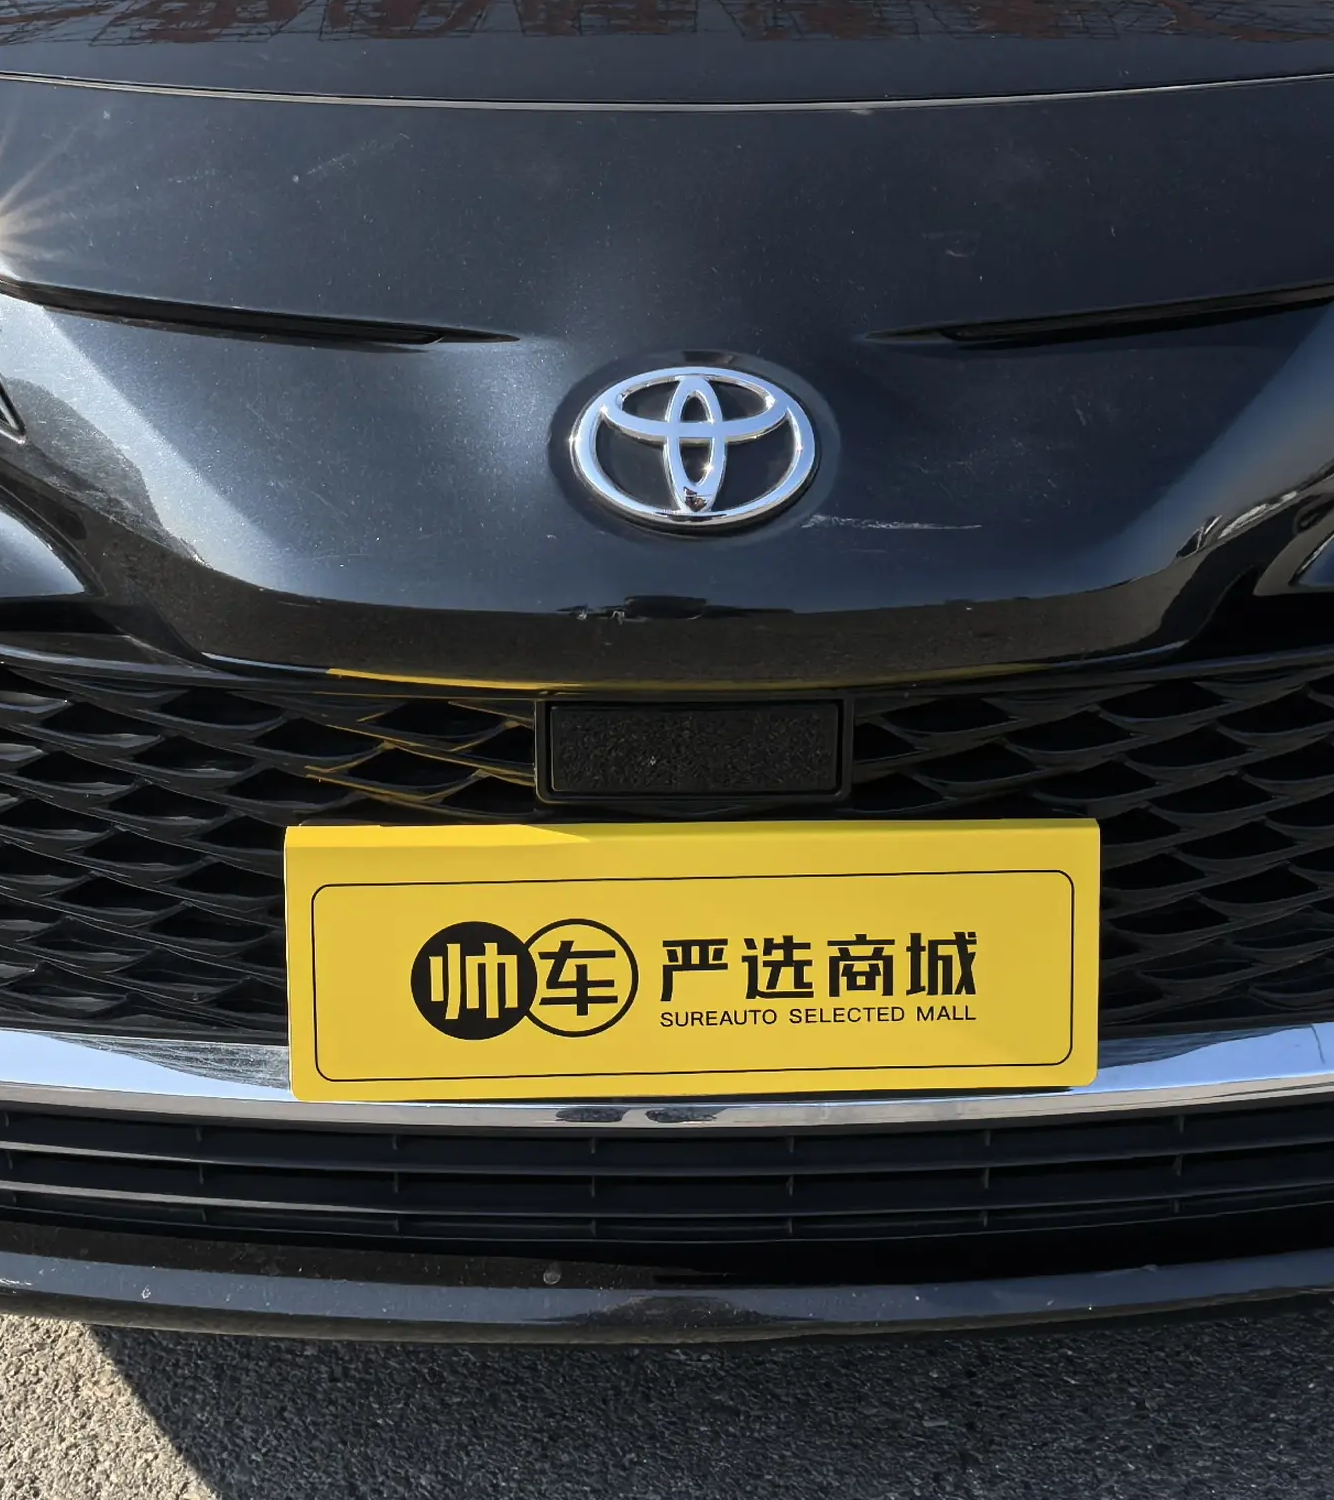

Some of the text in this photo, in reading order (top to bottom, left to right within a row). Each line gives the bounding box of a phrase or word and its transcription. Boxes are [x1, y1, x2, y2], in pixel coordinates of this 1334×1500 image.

[427, 931, 979, 1021] 帅车 严选商城
[659, 1004, 978, 1028] SUREAUTO SELECTED MALL
